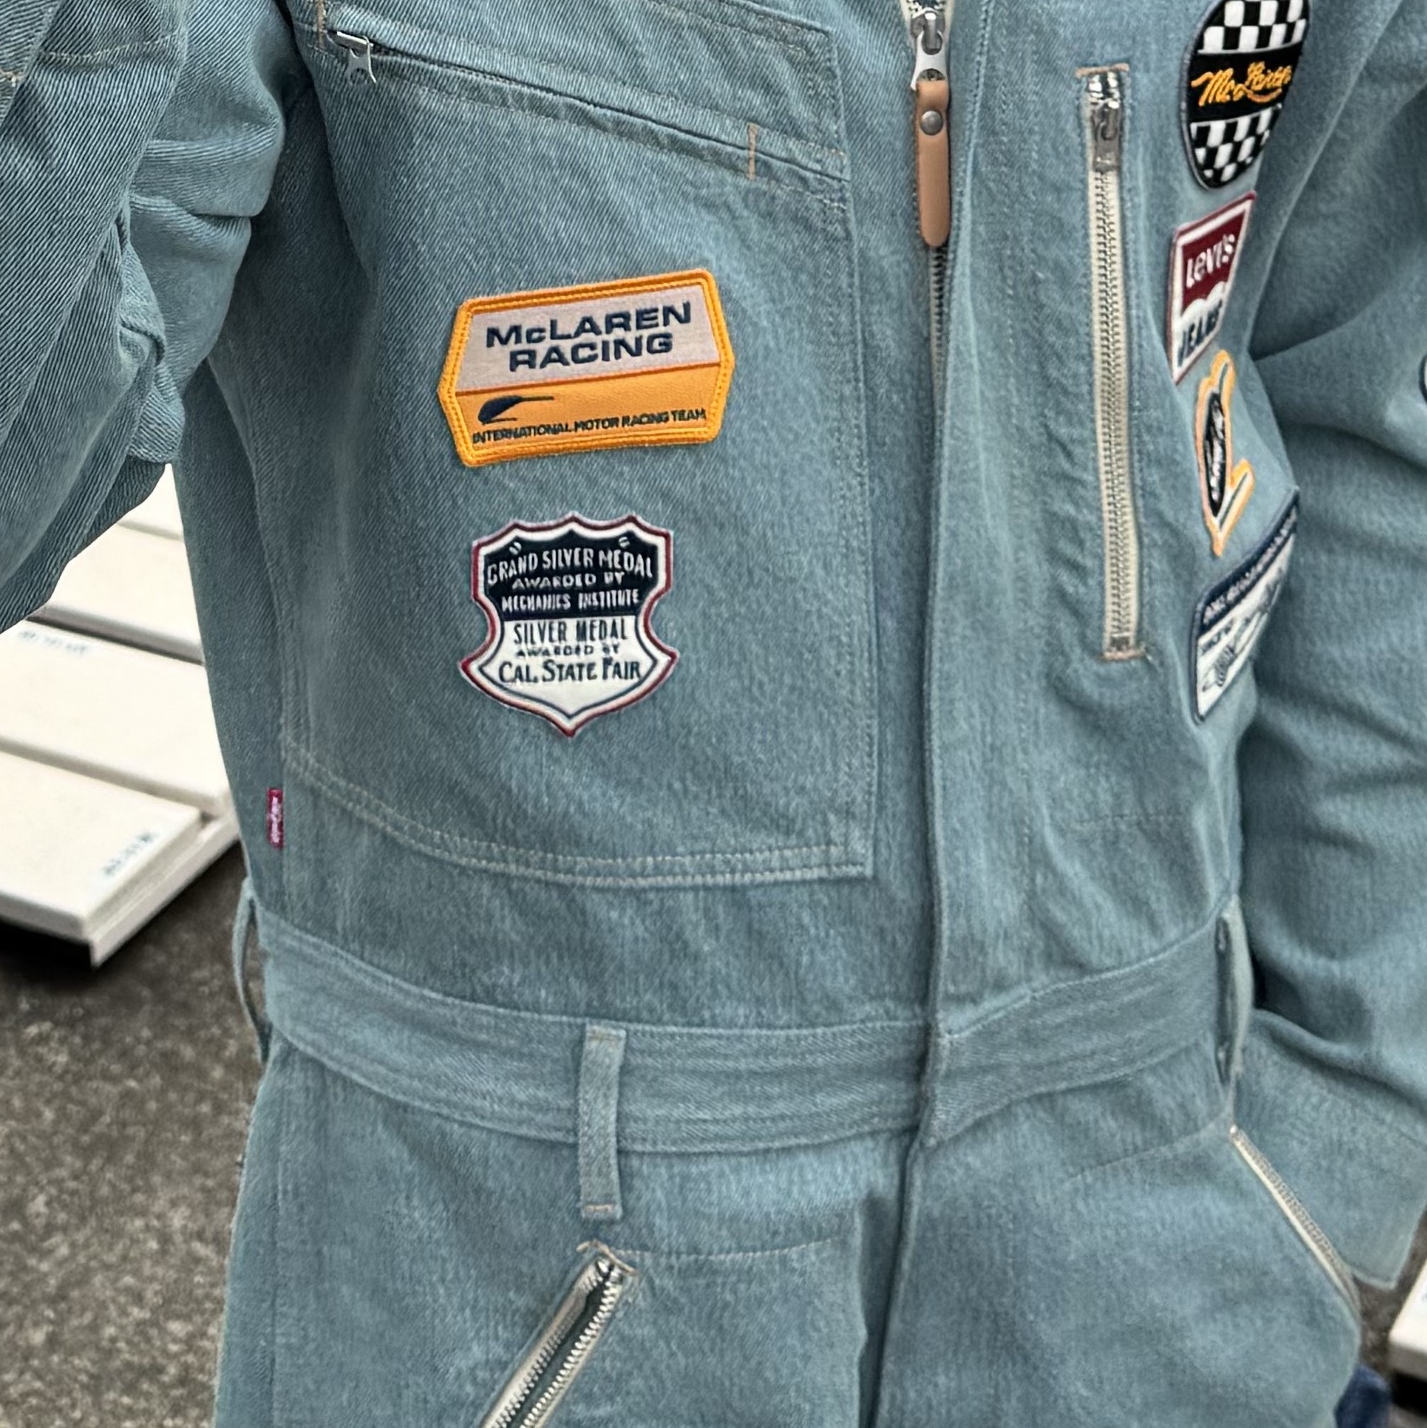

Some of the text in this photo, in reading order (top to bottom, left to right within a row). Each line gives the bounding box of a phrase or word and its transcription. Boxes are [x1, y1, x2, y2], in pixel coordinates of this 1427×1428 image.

[486, 300, 691, 349] McLAREN
[508, 332, 674, 373] RACING
[472, 407, 706, 445] INTERNATIONAL MOTOR RACING TEAM
[487, 547, 653, 586] GRAND SILVER MEDAL
[512, 574, 596, 590] AWARDED
[578, 589, 639, 610] INSTITUTE
[514, 618, 628, 645] SILVER MEDAL
[515, 645, 594, 658] AWARDED
